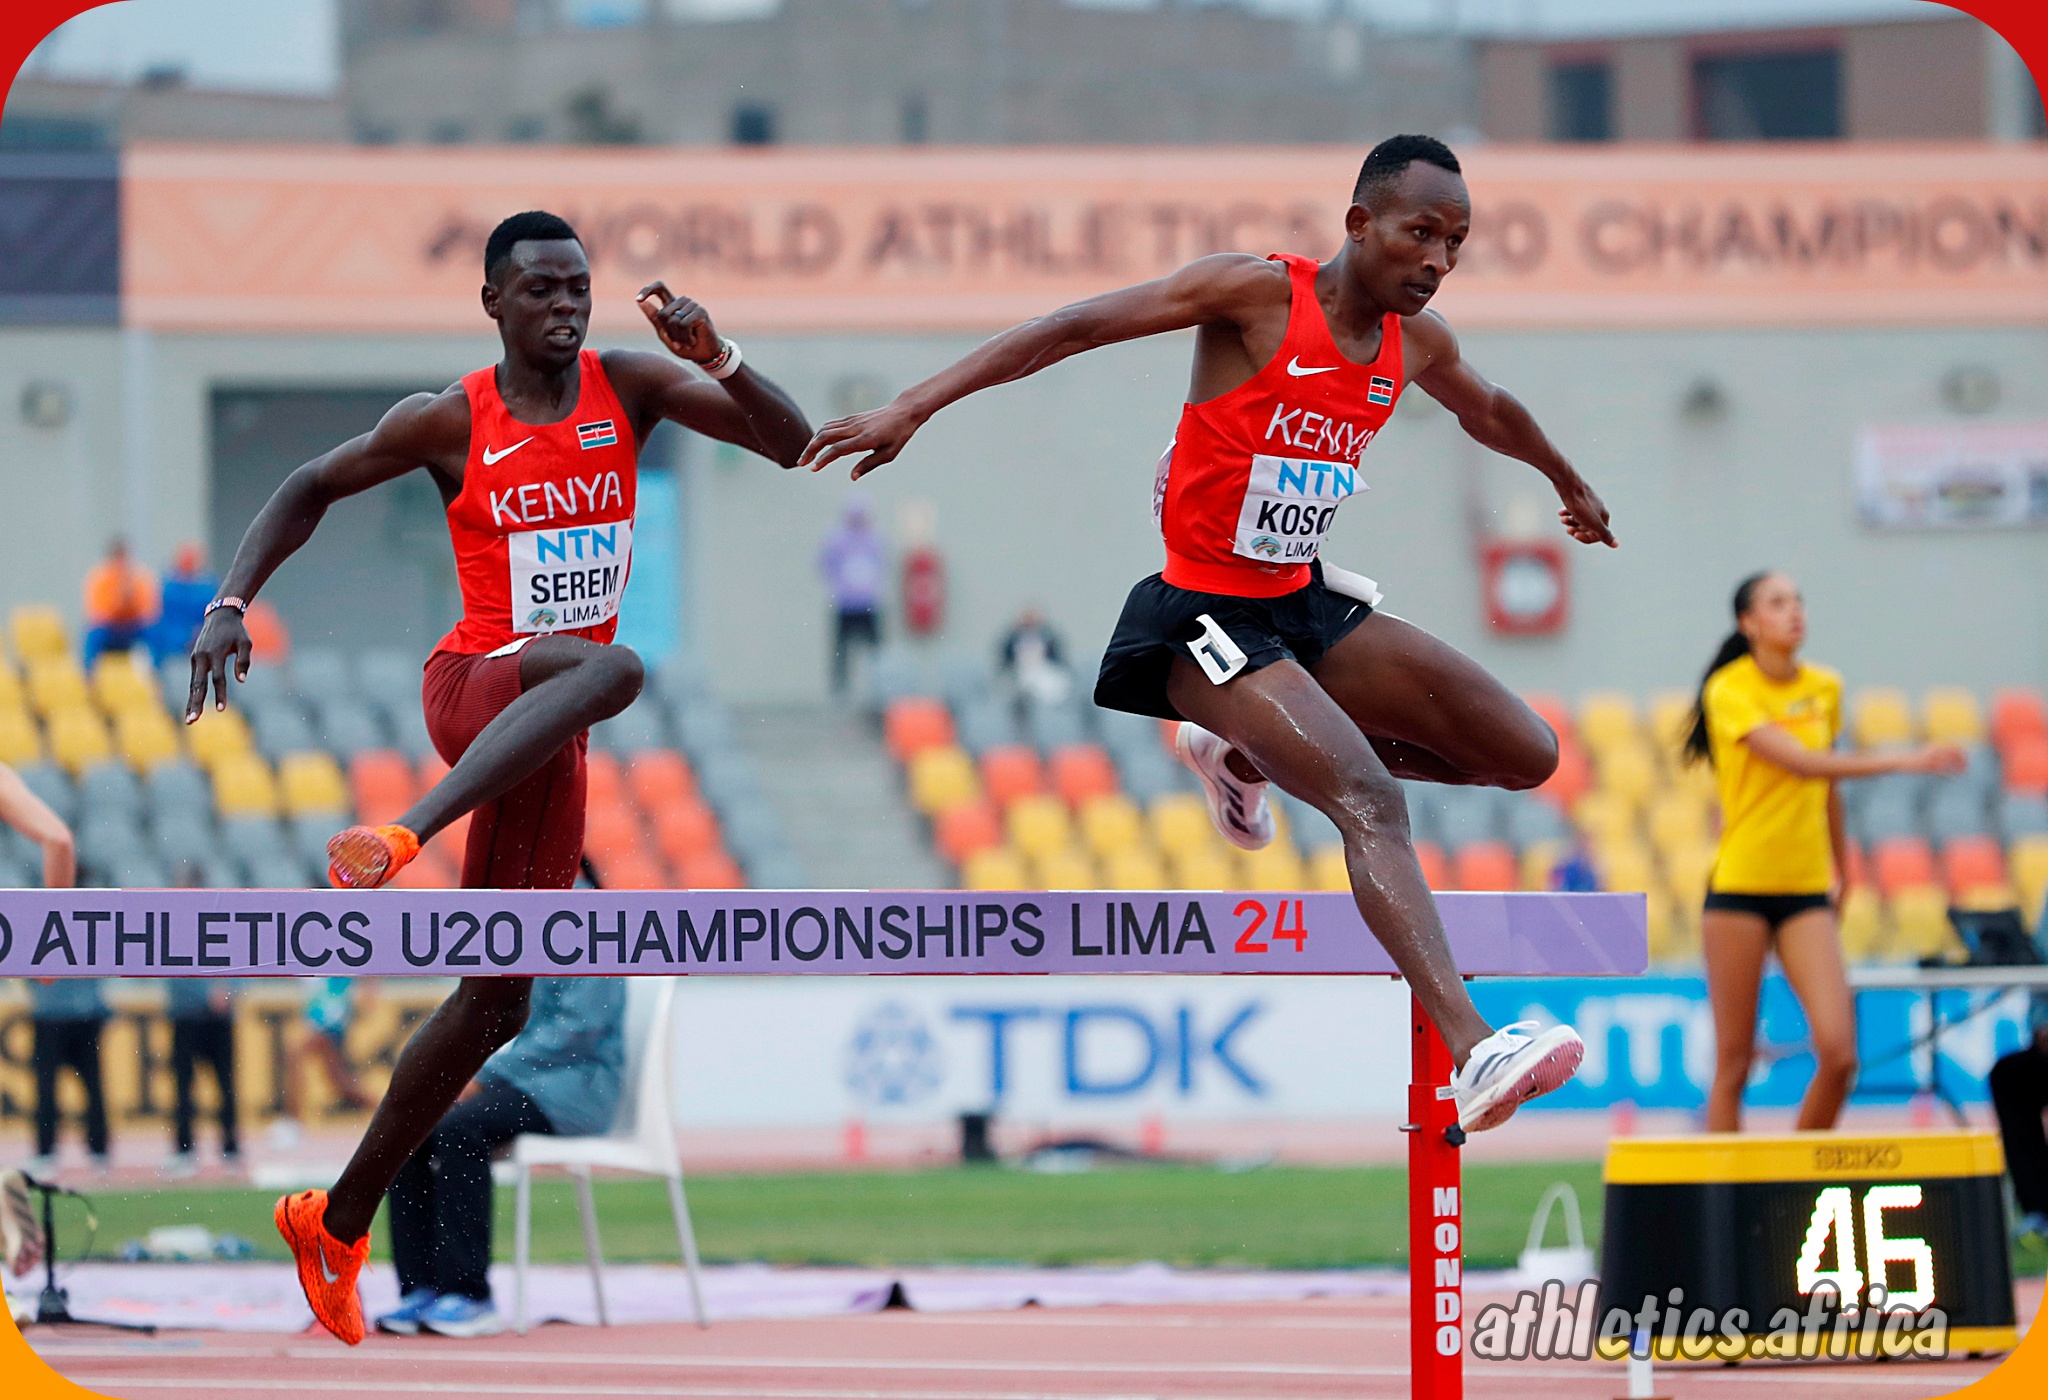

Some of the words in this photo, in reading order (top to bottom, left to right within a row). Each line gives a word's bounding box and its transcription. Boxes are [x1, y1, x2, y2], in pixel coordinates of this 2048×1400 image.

[489, 471, 623, 527] KENYA
[1277, 461, 1354, 498] NTN
[536, 525, 616, 564] NTN
[530, 565, 620, 605] SEREM
[563, 604, 600, 624] LIMA
[31, 911, 373, 967] ATHLETICS
[401, 911, 523, 967] U20
[542, 902, 1045, 966] CHAMPIONSHIPS
[1071, 901, 1216, 955] LIMA
[1232, 899, 1308, 954] 24
[949, 1001, 1270, 1099] TDK
[1813, 1144, 1903, 1170] SEIKO
[1433, 1187, 1461, 1355] MONDO
[1796, 1185, 1935, 1316] 46
